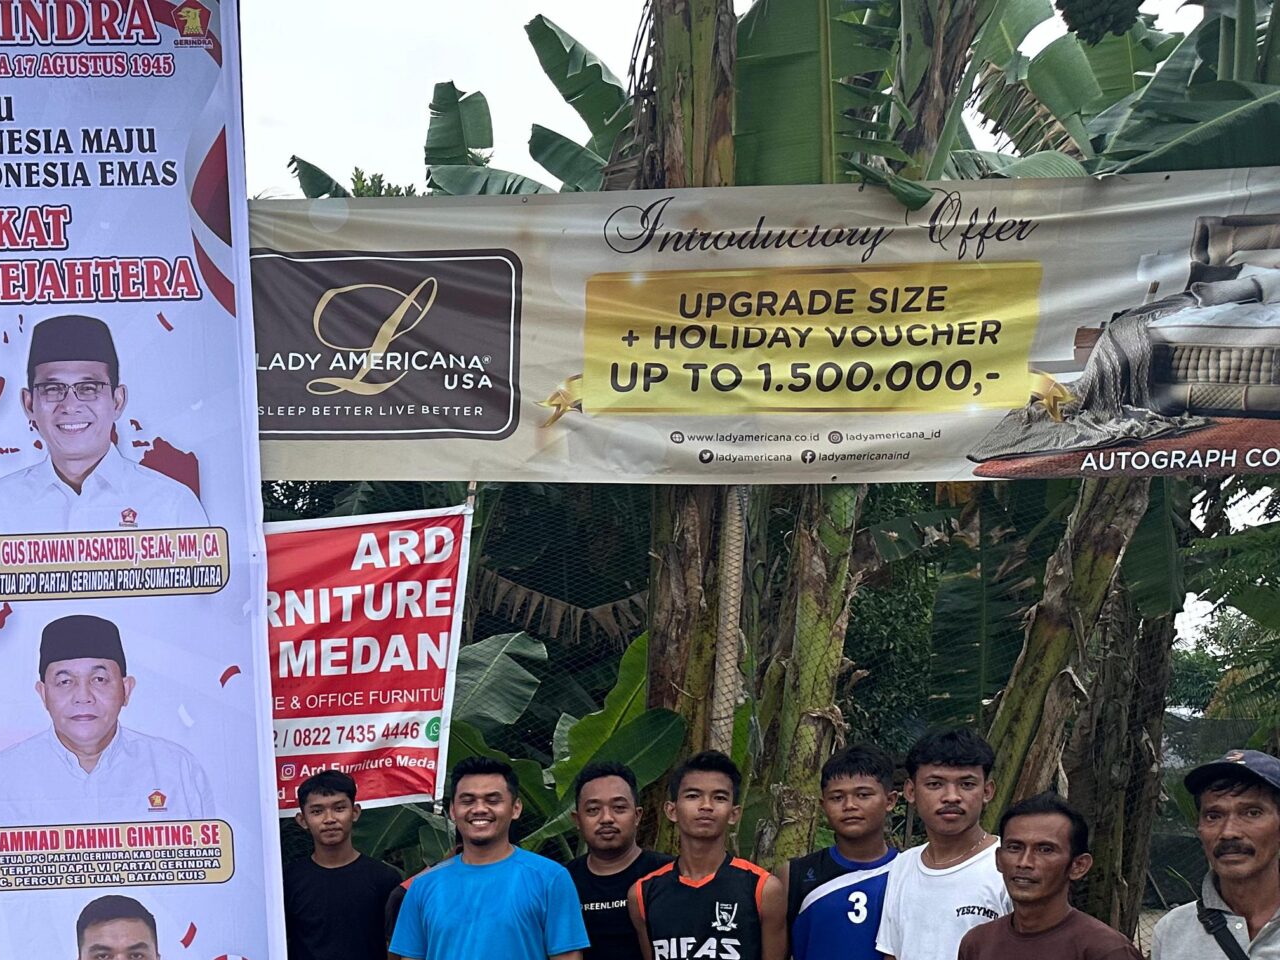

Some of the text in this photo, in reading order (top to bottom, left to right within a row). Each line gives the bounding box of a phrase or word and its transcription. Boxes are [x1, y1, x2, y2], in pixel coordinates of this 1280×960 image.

[15, 56, 34, 75] 17
[40, 55, 126, 76] AGUSTUS
[132, 55, 173, 75] 1945
[81, 127, 157, 153] MAJU
[99, 160, 177, 187] EMAS
[604, 196, 895, 263] Introductory
[679, 286, 948, 318] UPGRADE SIZE
[622, 320, 1002, 349] + HOLIDAY VOUCHER
[256, 352, 321, 371] LADY
[444, 374, 493, 389] USA
[610, 359, 1001, 396] UP TO 1.500.000,-
[258, 404, 483, 416] SLEEP BETTER LIVE BETTER
[687, 428, 941, 443] www.ladyamericana.co.id ladyamericana_id
[716, 450, 910, 463] ladyamericana ladyamericanaind
[1080, 447, 1280, 471] AUTOGRAPH CO
[2, 540, 25, 565] GUS
[28, 538, 74, 563] IRAWAN
[78, 536, 139, 564] PASARIBU,
[178, 534, 201, 562] MM,
[204, 534, 219, 557] CA
[351, 526, 454, 570] ARD
[19, 572, 37, 593] DPD
[39, 571, 69, 593] PARTAI
[71, 569, 114, 591] GERINDRA
[145, 566, 191, 588] SUMATERA
[193, 565, 221, 586] UTARA
[267, 578, 451, 627] RNITURE
[279, 632, 448, 678] MEDAN
[290, 695, 301, 709] &
[306, 692, 363, 709] OFFICE
[293, 721, 420, 747] 0822 7435 4446
[396, 755, 435, 769] Meda
[65, 828, 122, 850] DAHNIL
[127, 825, 197, 848] GINTING,
[201, 824, 219, 845] SE
[2, 864, 55, 875] TERPILIH
[59, 862, 94, 873] DAPIL
[99, 862, 111, 872] VI
[114, 860, 155, 871] PARTAI
[159, 859, 220, 870] GERINDRA
[26, 854, 45, 864] DPC
[48, 852, 81, 863] PARTAI
[83, 851, 131, 862] GERINDRA
[133, 850, 151, 860] KAB
[154, 849, 175, 859] DELI
[177, 848, 221, 858] SERDANG
[16, 875, 63, 887] PERCUT
[67, 874, 86, 884] SEI
[90, 873, 124, 884] TUAN,
[129, 871, 173, 882] BATANG
[177, 870, 205, 880] KUIS
[580, 899, 629, 911] REENLIGH
[847, 891, 868, 924] 3
[653, 936, 741, 960] RIFAS
